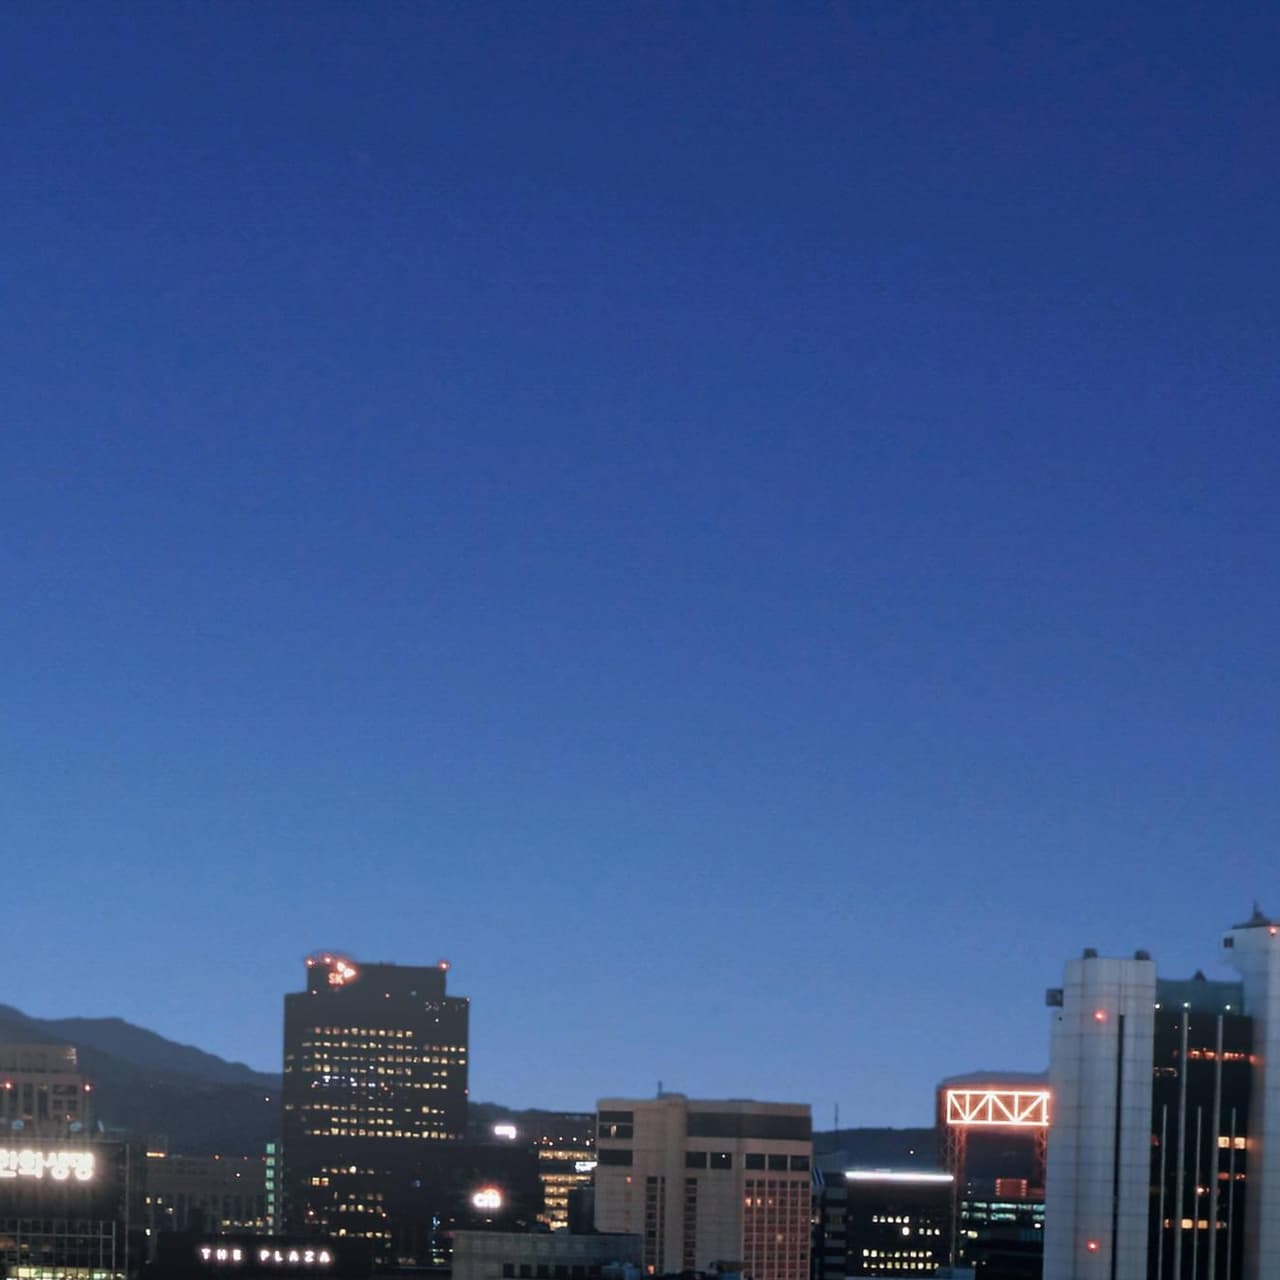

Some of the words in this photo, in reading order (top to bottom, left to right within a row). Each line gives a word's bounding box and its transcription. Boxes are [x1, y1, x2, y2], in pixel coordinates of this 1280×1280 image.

[328, 973, 344, 985] SK
[201, 1248, 242, 1261] THE
[260, 1249, 332, 1263] PLAZA
